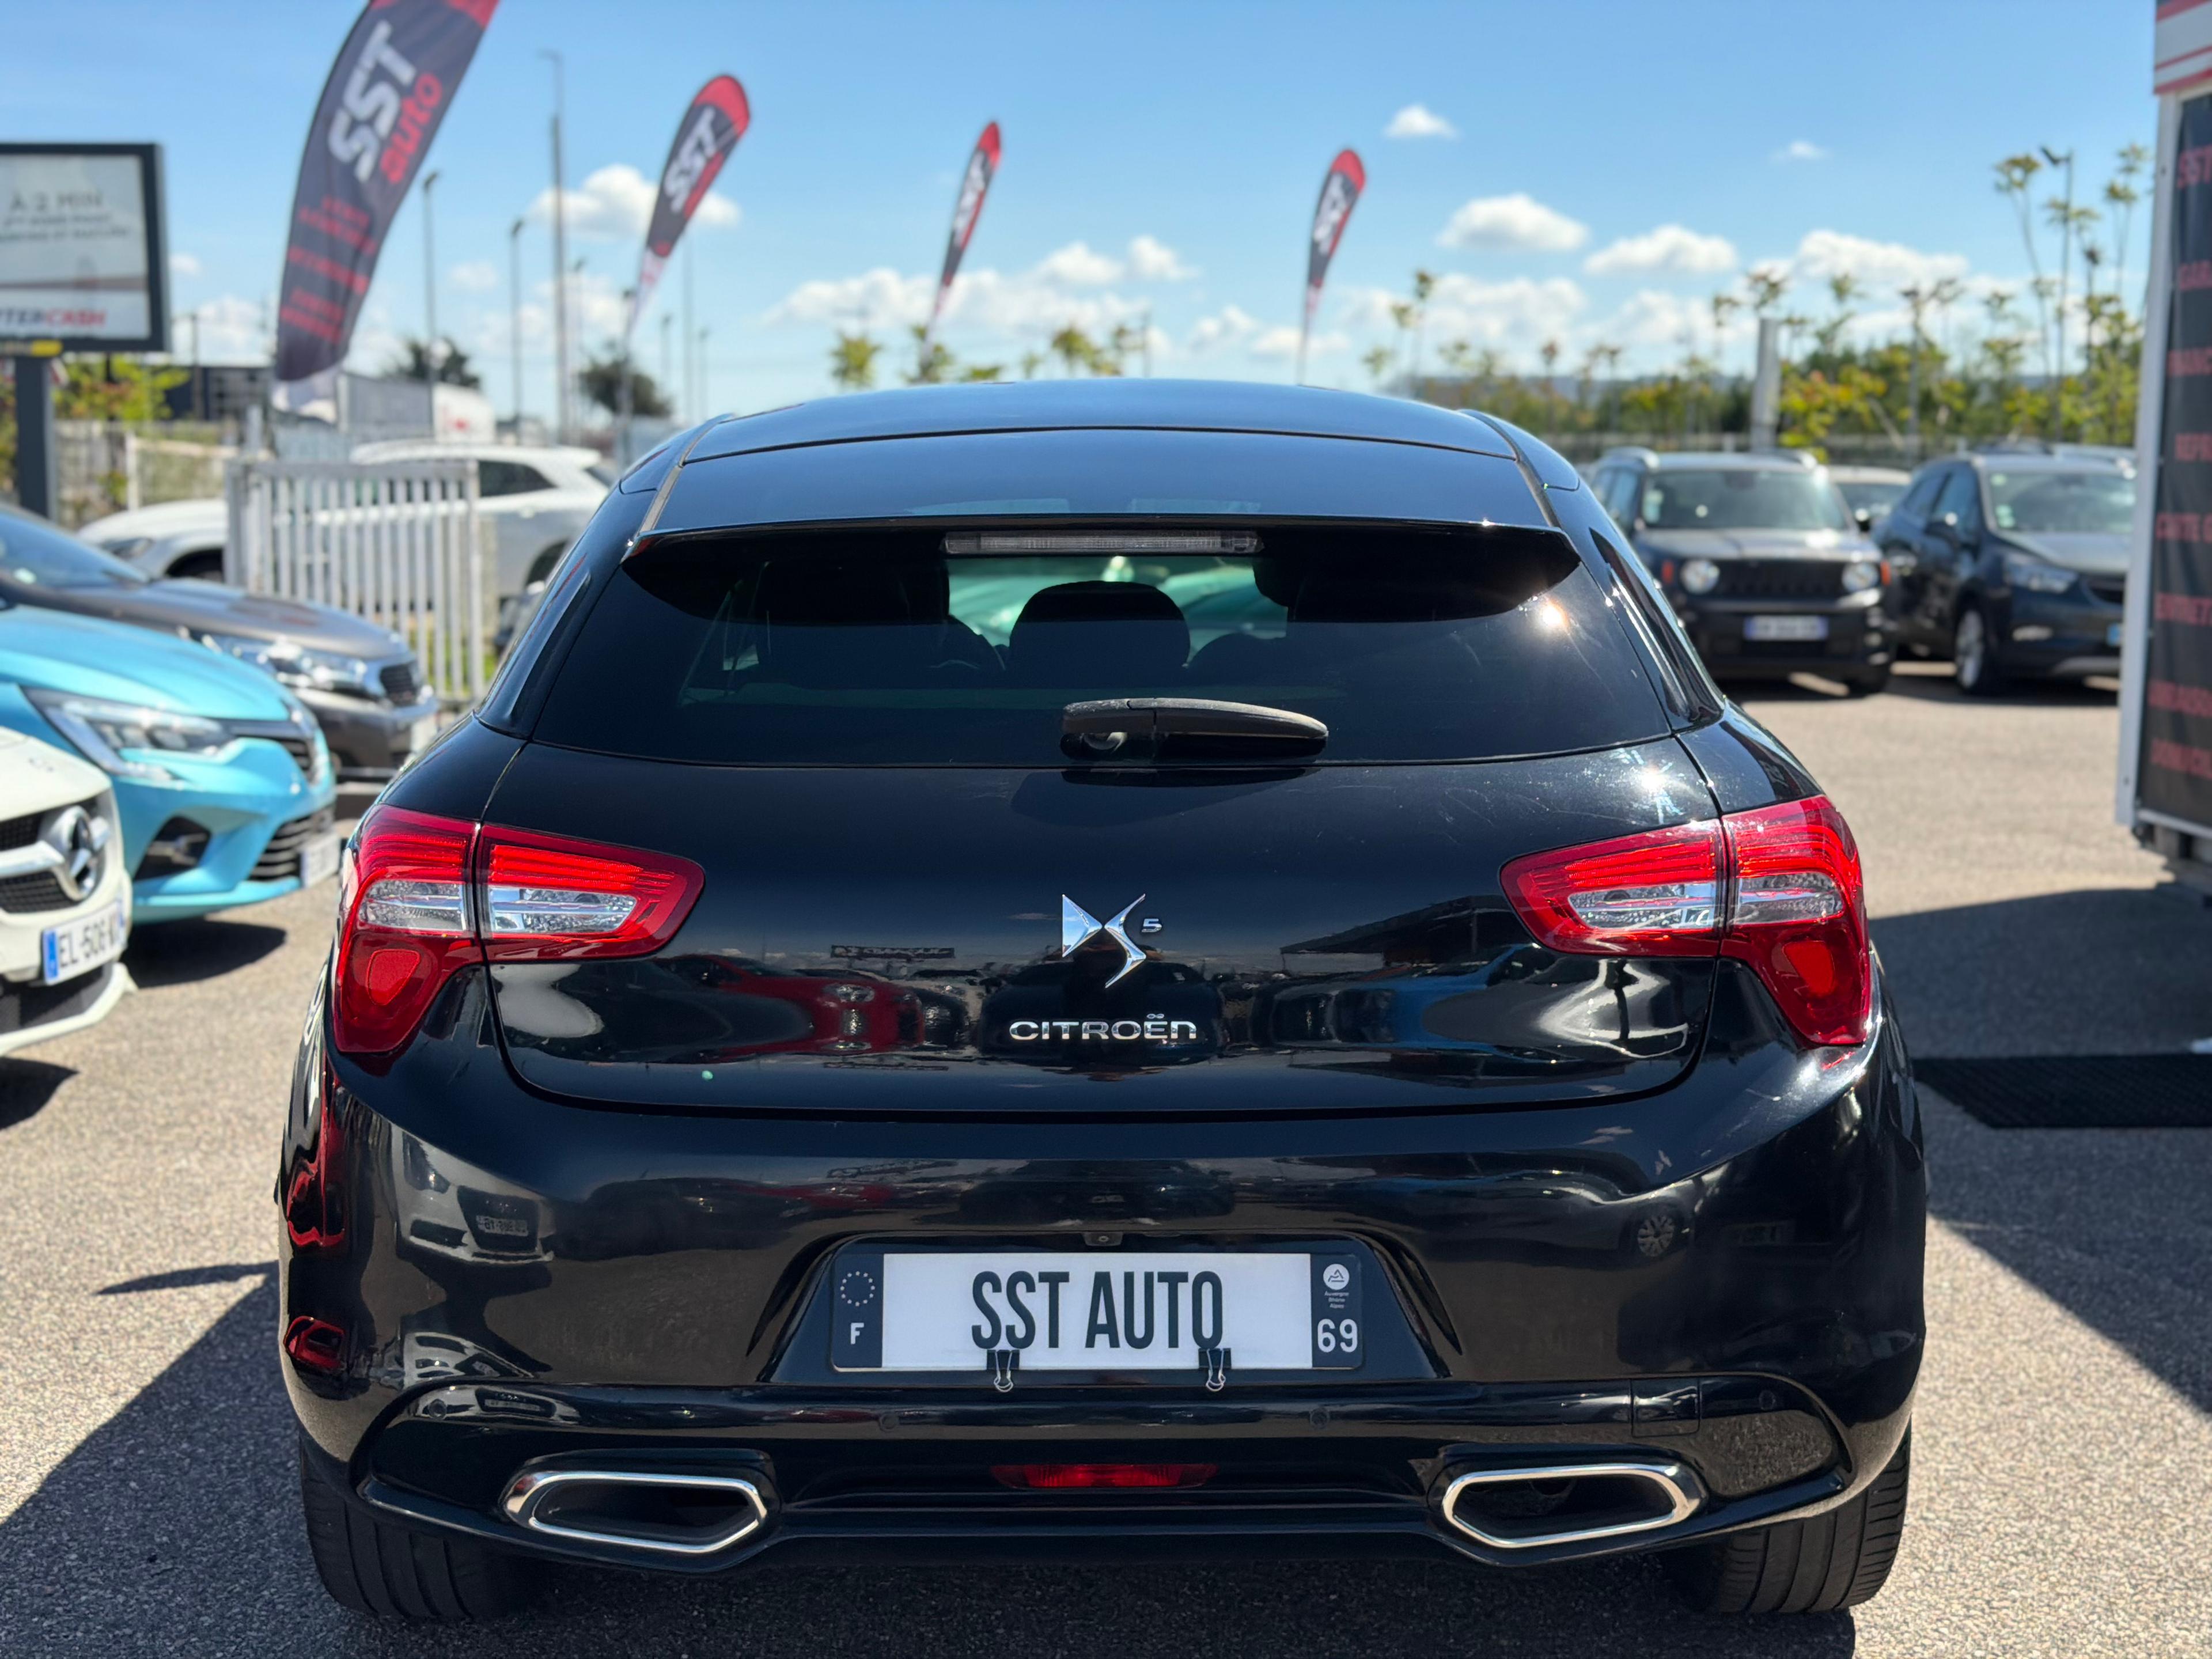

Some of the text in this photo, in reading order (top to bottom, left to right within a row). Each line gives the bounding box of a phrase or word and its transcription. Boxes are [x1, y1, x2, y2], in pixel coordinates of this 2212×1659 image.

[327, 20, 416, 183] SST
[1141, 918, 1162, 933] 5
[1009, 1013, 1197, 1040] CITROËN
[972, 1271, 1222, 1349] SST AUTO
[850, 1323, 865, 1344] F
[1317, 1319, 1358, 1353] 69
